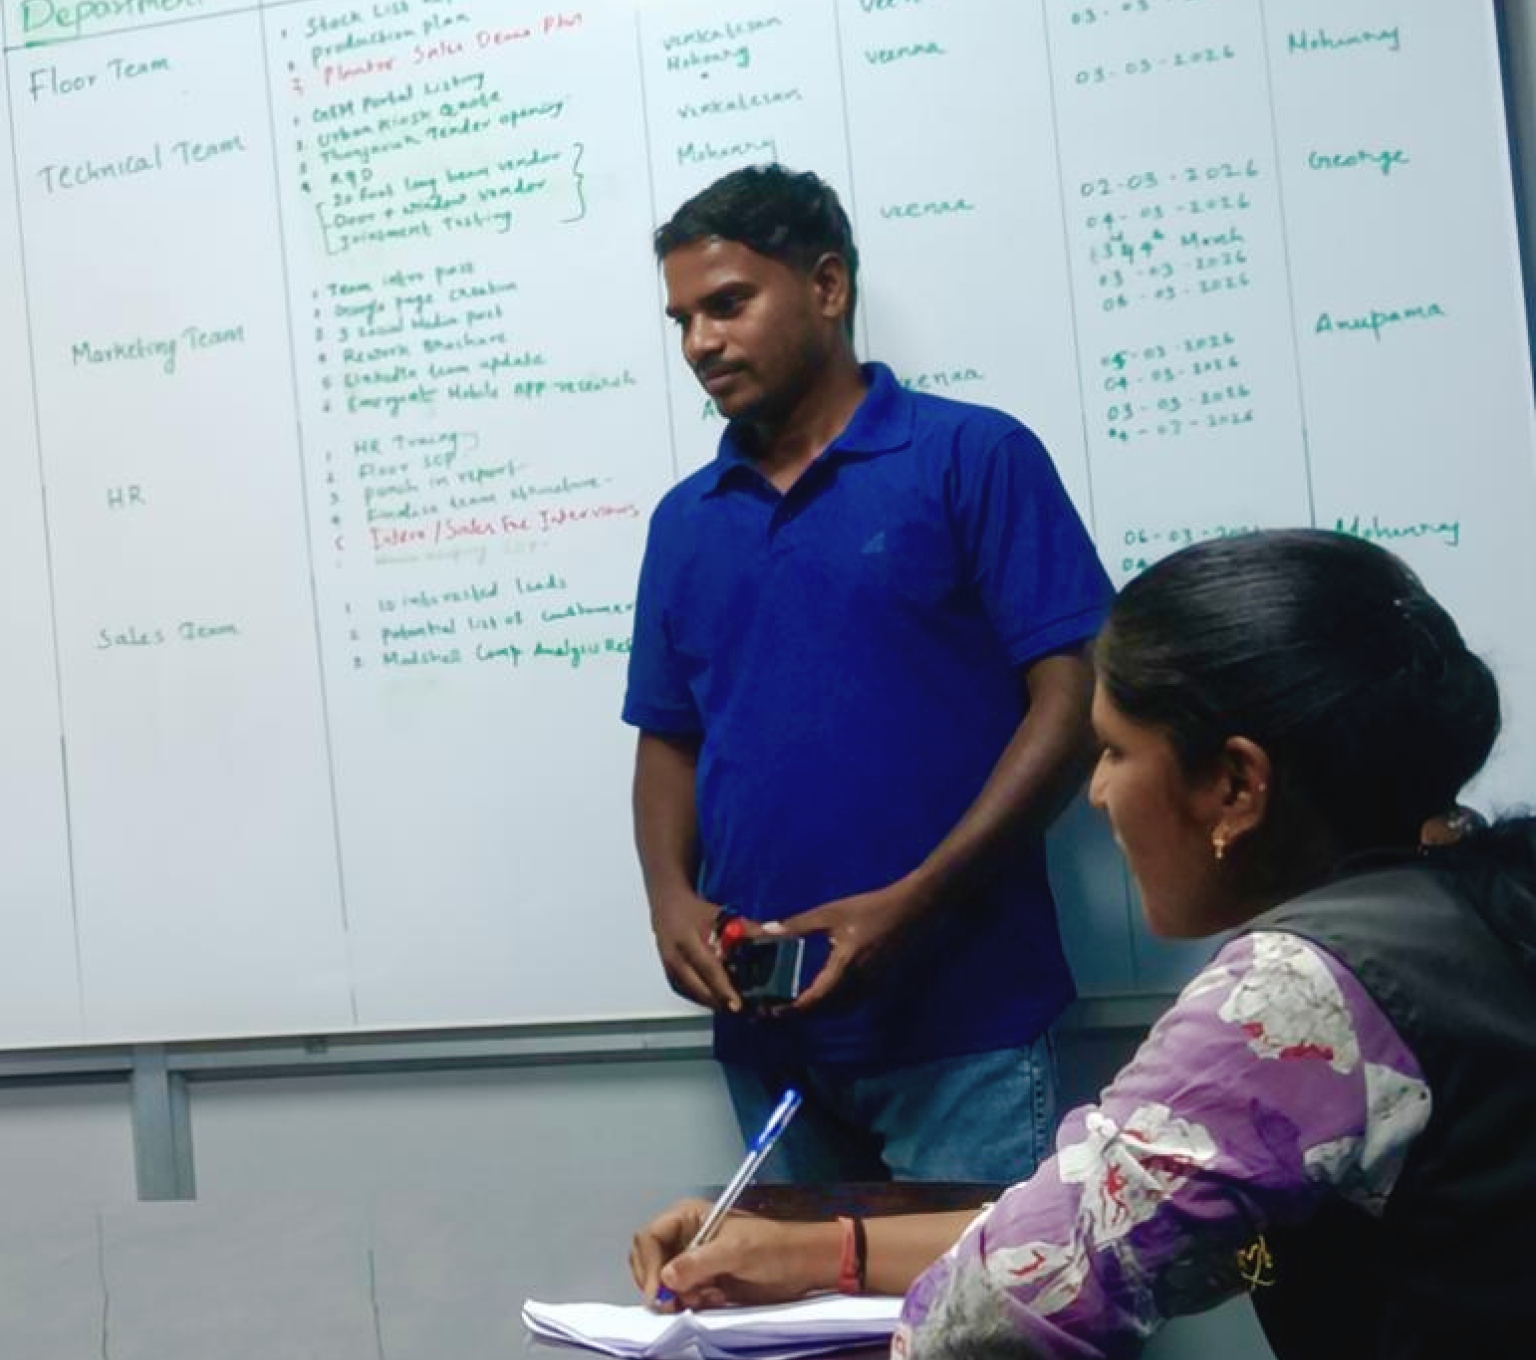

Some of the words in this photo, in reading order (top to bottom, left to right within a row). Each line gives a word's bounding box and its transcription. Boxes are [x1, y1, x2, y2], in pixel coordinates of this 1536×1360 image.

[29, 65, 97, 103] Floor
[107, 58, 170, 80] Team
[172, 135, 245, 165] Team
[72, 338, 177, 374] Marketing
[182, 325, 244, 349] Team
[107, 485, 146, 509] HR
